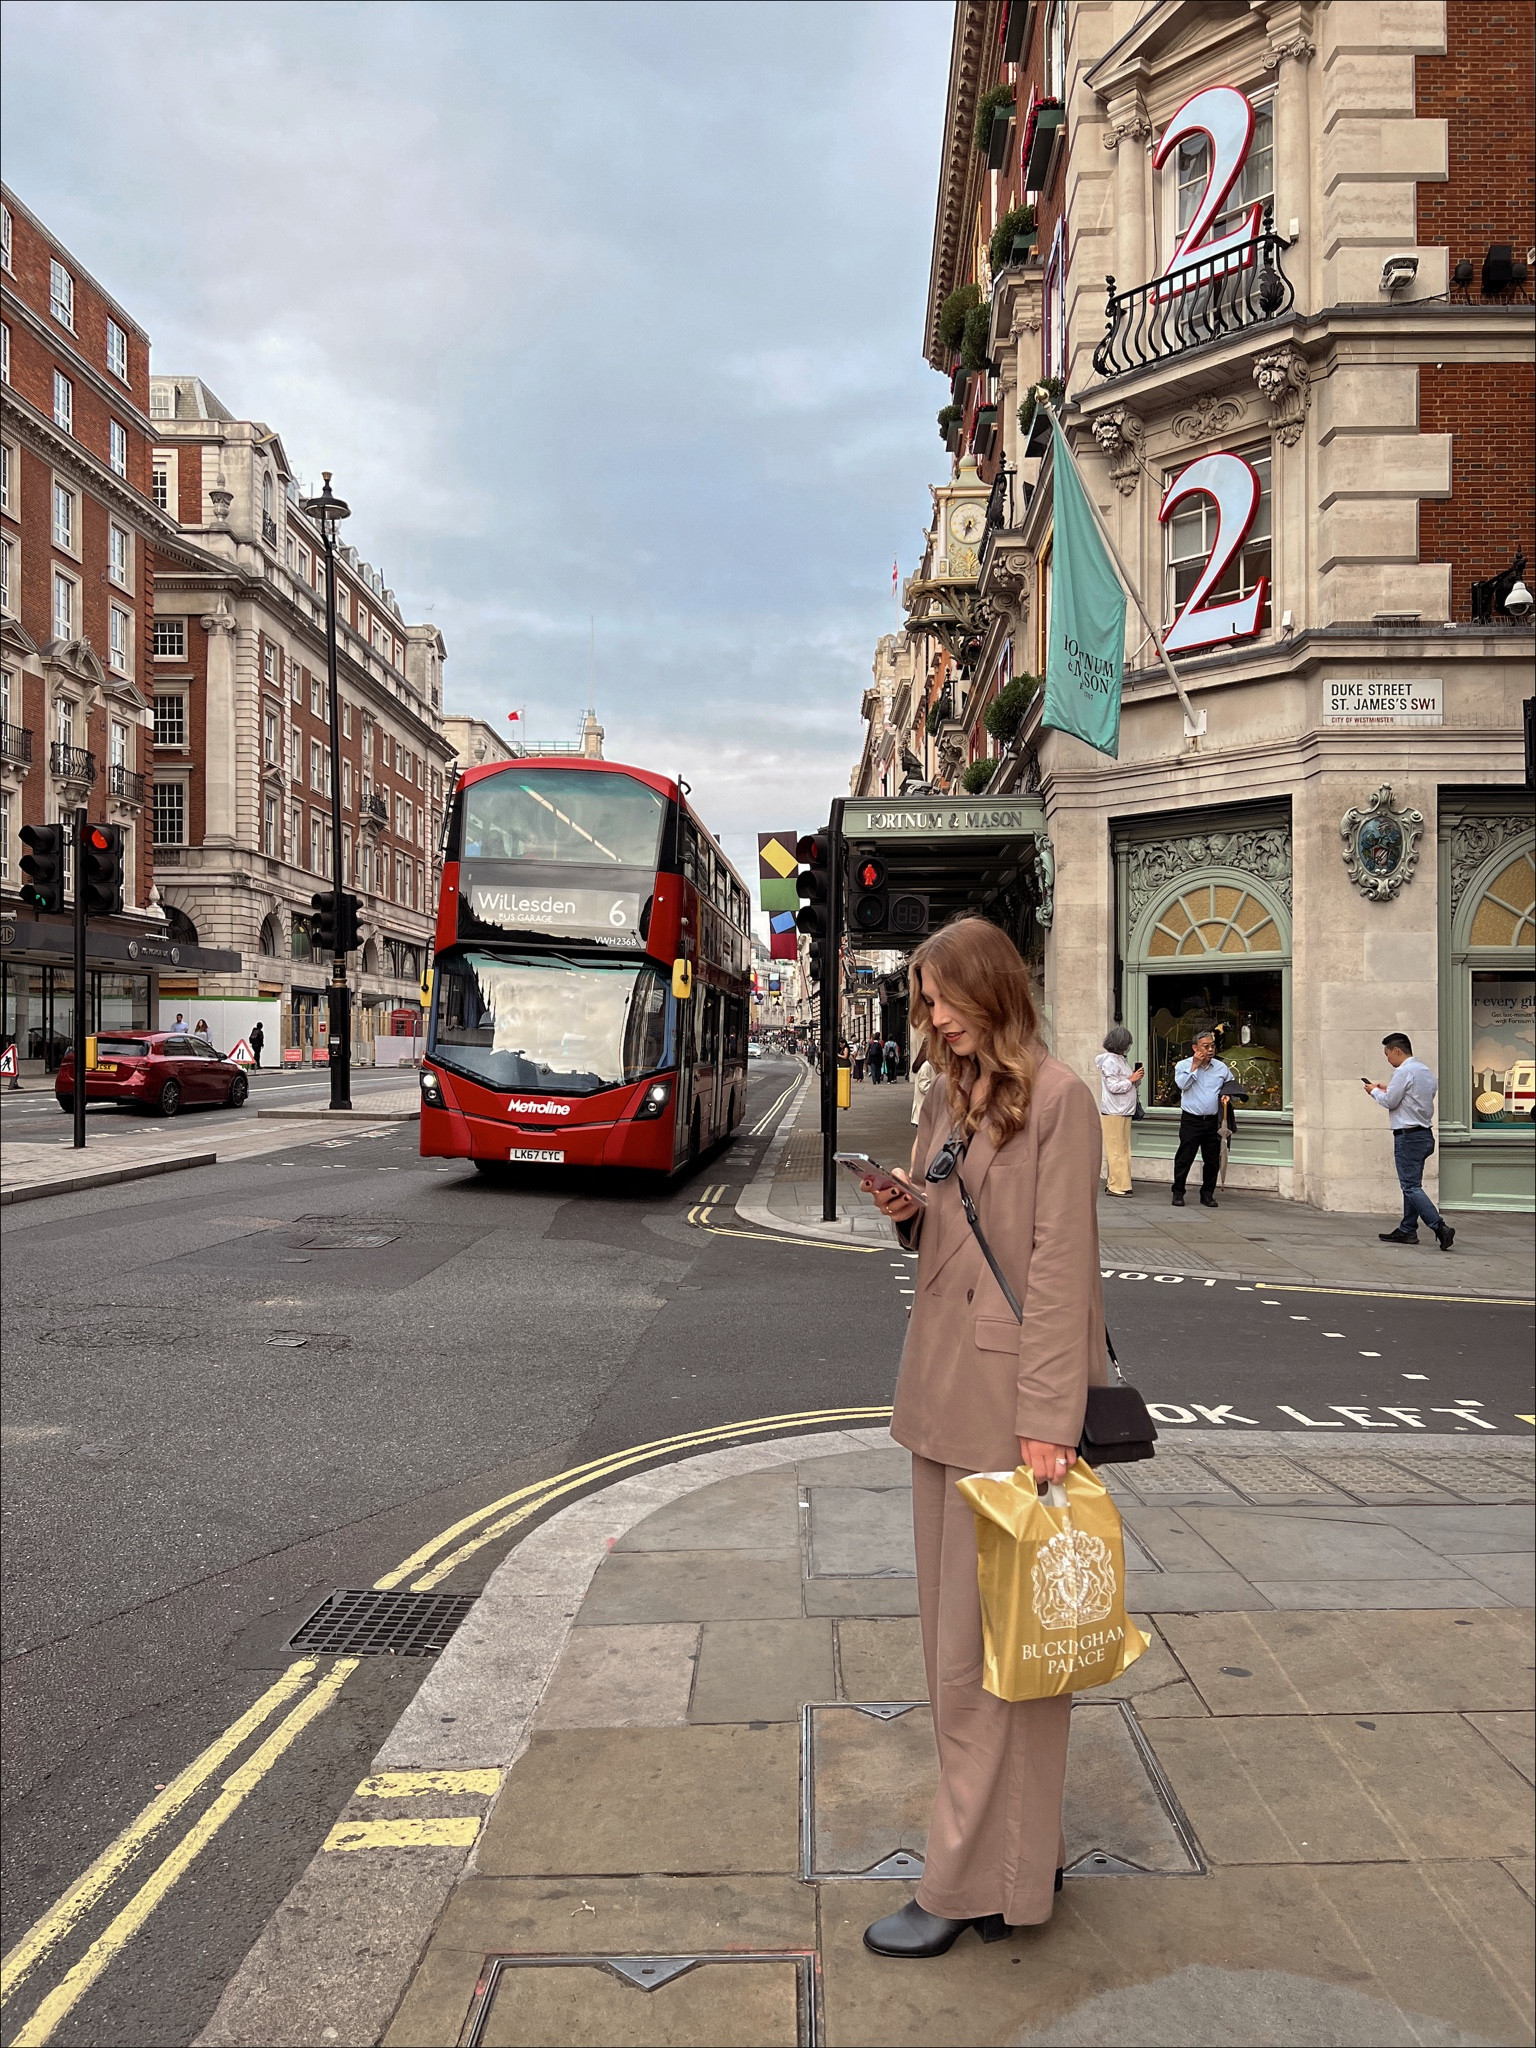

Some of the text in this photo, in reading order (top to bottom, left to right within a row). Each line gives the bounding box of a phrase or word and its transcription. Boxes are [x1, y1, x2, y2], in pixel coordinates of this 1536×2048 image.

[1150, 85, 1264, 305] 2
[1155, 452, 1269, 656] 2
[1331, 683, 1413, 696] DUKE STREET
[1331, 697, 1436, 711] ST. JAMES'S SW1
[1354, 716, 1394, 724] WESTMINSTER
[866, 811, 1023, 829] FORTNUM & MASON
[477, 892, 628, 927] Willesden 6
[498, 912, 553, 924] BUS GARAGE
[594, 935, 637, 947] VWH2368
[1483, 997, 1518, 1009] every
[1520, 995, 1536, 1010] gi
[507, 1098, 571, 1116] Metroline
[514, 1149, 560, 1161] LK67 CYC
[1145, 1403, 1498, 1429] OK LEFT
